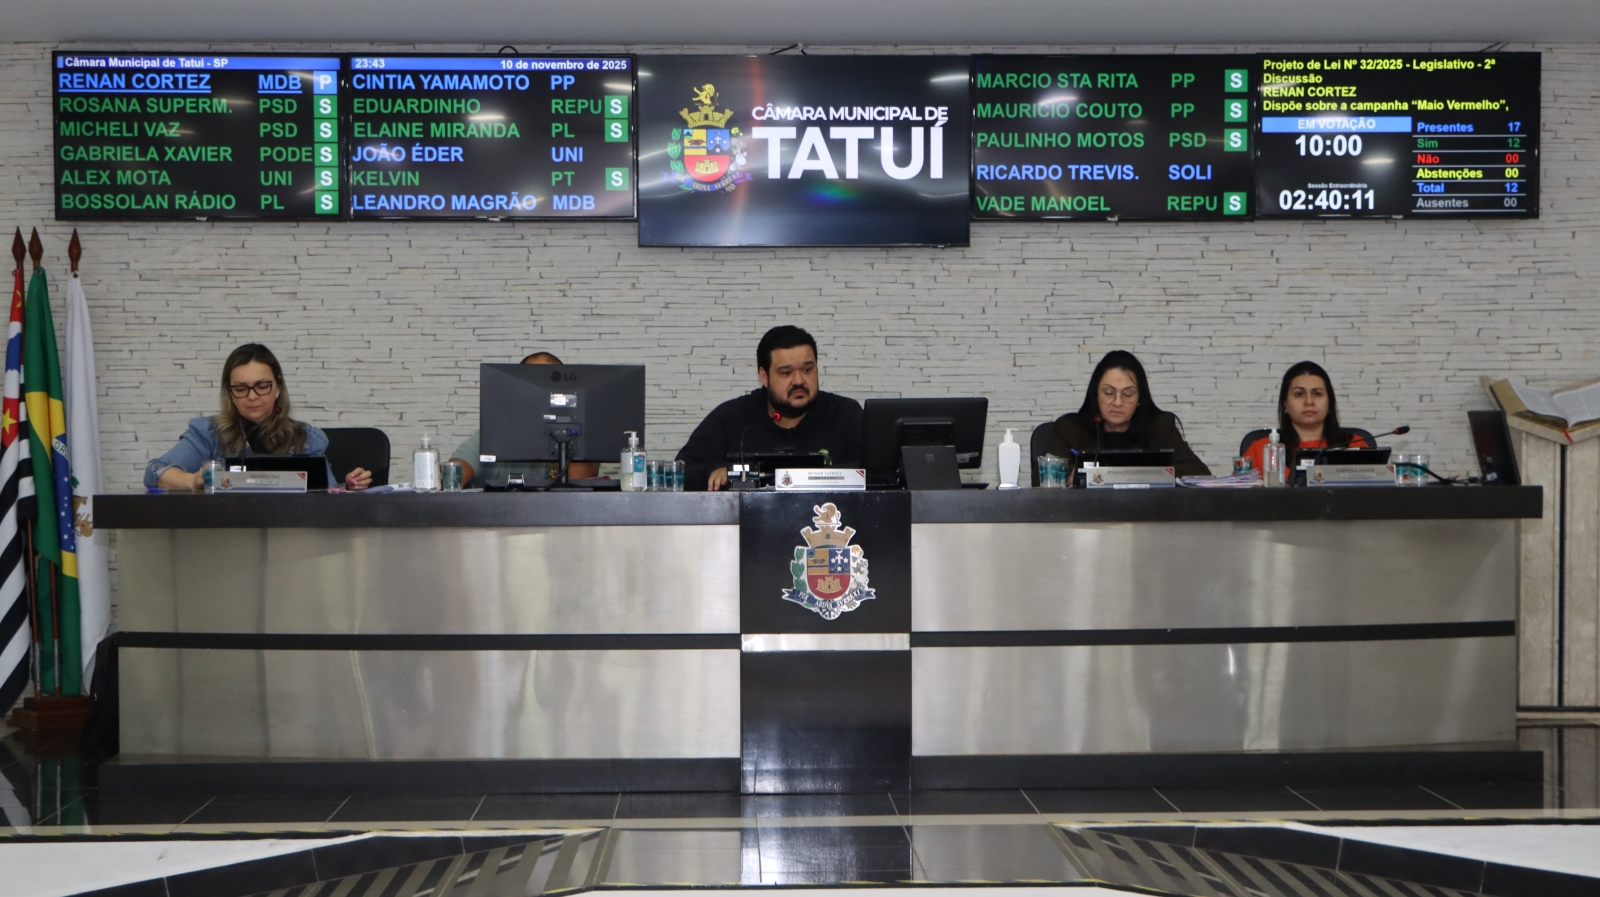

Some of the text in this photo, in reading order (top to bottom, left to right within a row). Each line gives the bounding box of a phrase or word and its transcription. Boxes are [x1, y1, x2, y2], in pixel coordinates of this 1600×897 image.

[65, 57, 106, 68] Câmara
[109, 58, 159, 69] Municipal
[162, 58, 176, 68] de
[178, 58, 205, 68] Tatuí
[213, 59, 228, 67] SP
[355, 59, 385, 68] 23:43
[501, 60, 627, 70] 10 de novembro de 2025
[1264, 60, 1305, 71] Projeto
[1308, 60, 1320, 69] de
[1324, 60, 1341, 70] Lei
[1344, 60, 1357, 69] Nº
[1360, 60, 1403, 70] 32/2025
[1413, 60, 1474, 71] Legislativo
[1484, 59, 1495, 69] 2ª
[59, 74, 332, 89] RENAN CORTEZ MDB P
[353, 74, 575, 90] CINTIA YAMAMOTO PP
[977, 73, 1243, 88] MARCIO STA RITA PP S
[1264, 74, 1322, 83] Discussão
[1263, 87, 1357, 97] RENAN CORTEZ
[59, 98, 332, 114] ROSANA SUPERM. PSD S
[354, 99, 622, 114] EDUARDINHO REPU S
[751, 103, 948, 121] CÂMARA MUNICIPAL DE
[977, 103, 1242, 118] MAURICIO COUTO PP S
[1263, 100, 1302, 112] Dispõe
[1305, 100, 1338, 110] sobre
[1350, 100, 1408, 112] campanha
[60, 122, 332, 138] MICHELI VAZ PSD S
[354, 123, 622, 138] ELAINE MIRANDA PL S
[1298, 118, 1376, 131] EM VOTAÇÃO
[1417, 122, 1521, 134] Presentes 17
[977, 133, 1242, 148] PAULINHO MOTOS PSD S
[1295, 135, 1362, 156] 10:00
[1417, 138, 1520, 148] Sim 12
[61, 146, 332, 162] GABRIELA XAVIER PODE S
[352, 143, 583, 162] JOÃO ÉDER UNI
[752, 120, 948, 180] TATUÍ
[1417, 153, 1519, 164] Não 00
[61, 170, 333, 186] ALEX MOTA UNI S
[353, 171, 623, 186] KELVIN PT S
[977, 165, 1212, 180] RICARDO TREVIS. SOLI
[1417, 168, 1518, 180] Abstenções 00
[1417, 183, 1518, 193] Total 12
[62, 191, 333, 210] BOSSOLAN RÁDIO PL S
[353, 192, 595, 211] LEANDRO MAGRÃO MDB
[976, 196, 1241, 211] VADE MANOEL REPU S
[1279, 190, 1374, 211] 02:40:11
[1416, 198, 1517, 208] Ausentes 00
